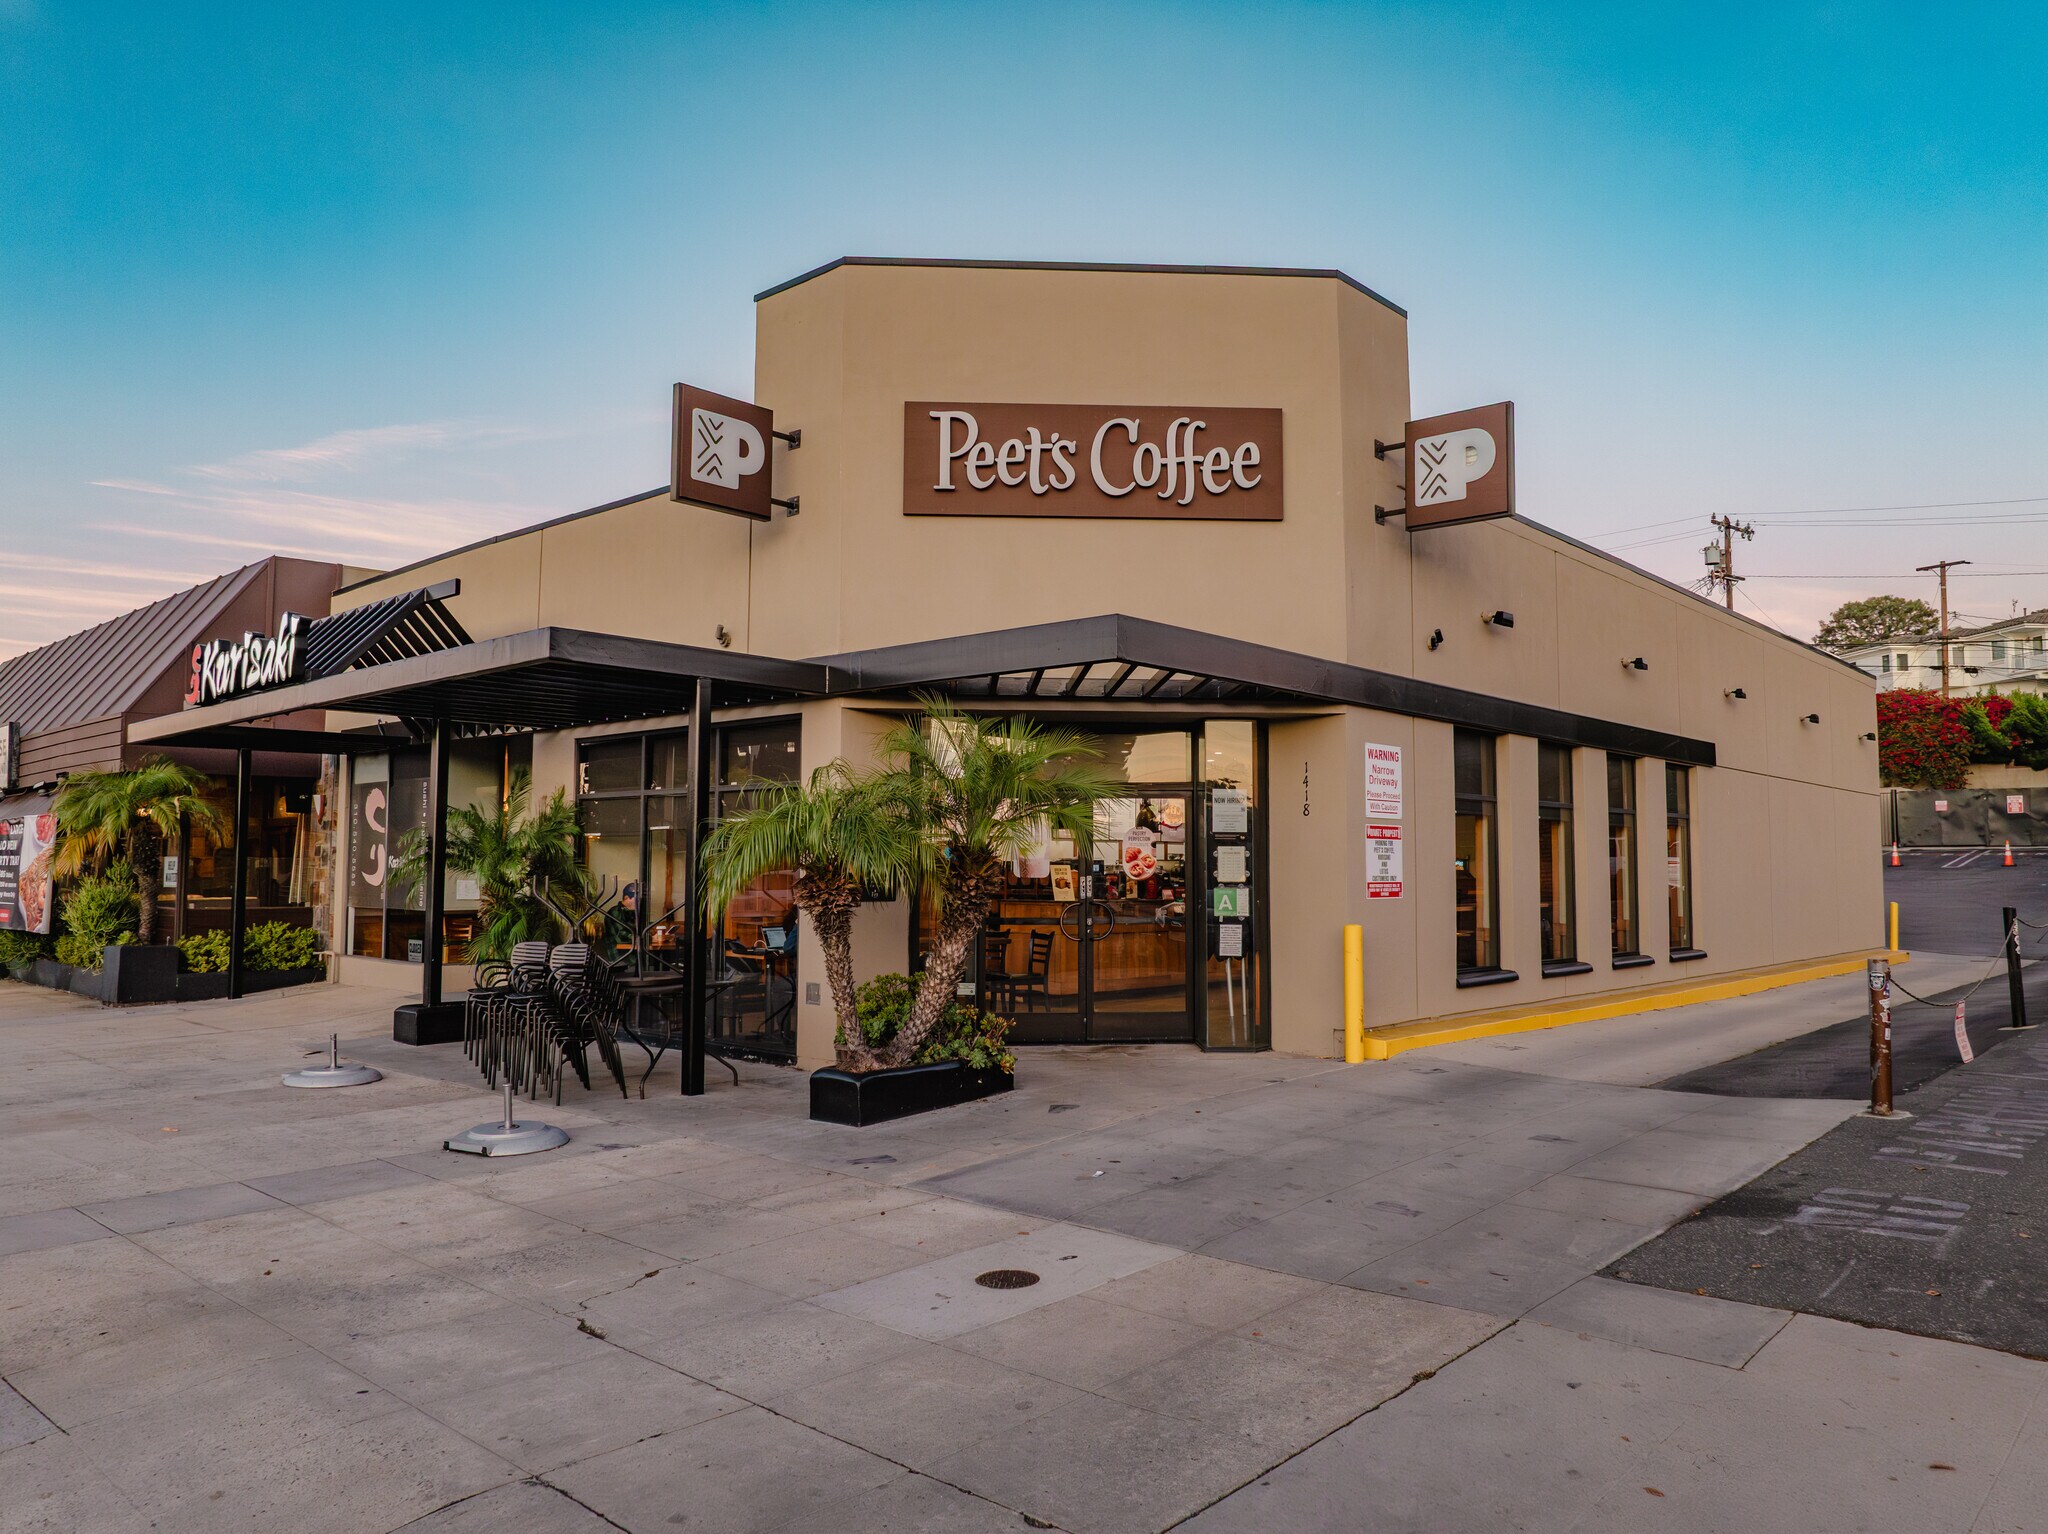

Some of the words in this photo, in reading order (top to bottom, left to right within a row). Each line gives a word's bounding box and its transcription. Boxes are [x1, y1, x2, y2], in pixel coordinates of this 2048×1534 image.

[929, 410, 1077, 495] Peet's
[1090, 416, 1262, 505] Coffee
[201, 611, 300, 703] Kurisaki
[1367, 748, 1399, 763] WARNING
[1371, 764, 1395, 776] Narrow
[1302, 761, 1310, 817] 1418
[1368, 774, 1398, 790] Driveway
[1367, 790, 1382, 799] Please
[1382, 791, 1401, 800] Proceed
[1370, 802, 1381, 810] With
[1381, 803, 1399, 811] Caution
[1218, 894, 1233, 911] A
